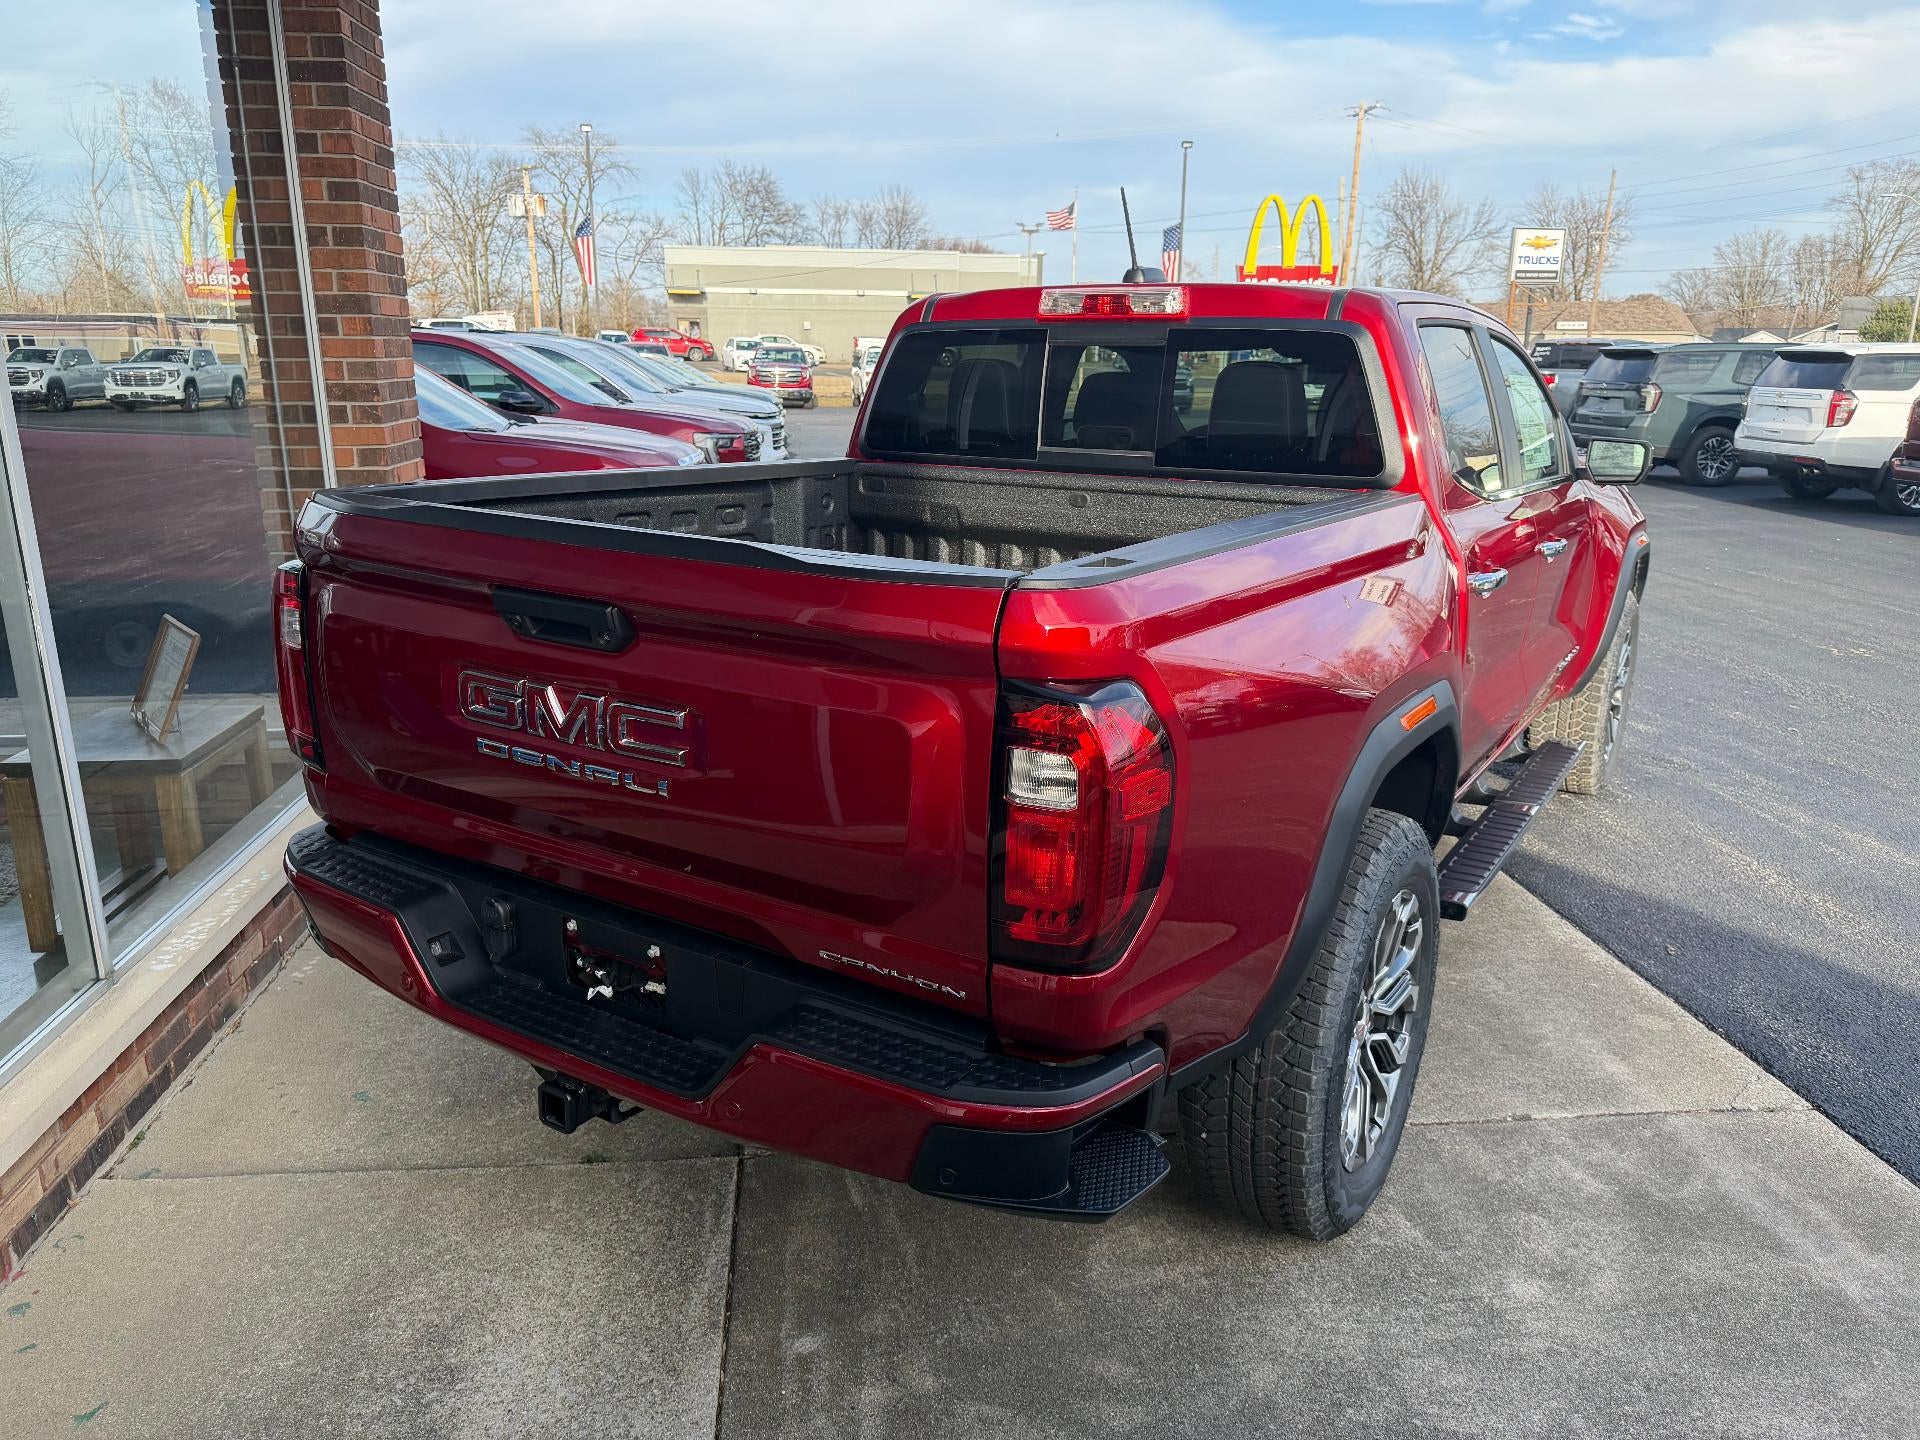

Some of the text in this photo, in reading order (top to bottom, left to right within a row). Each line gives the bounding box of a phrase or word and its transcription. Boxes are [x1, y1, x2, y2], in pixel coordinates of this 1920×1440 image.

[1517, 256, 1559, 265] TRUCKS
[458, 670, 689, 767] GMC
[476, 736, 668, 799] DENALI
[819, 950, 966, 1000] CANYON
